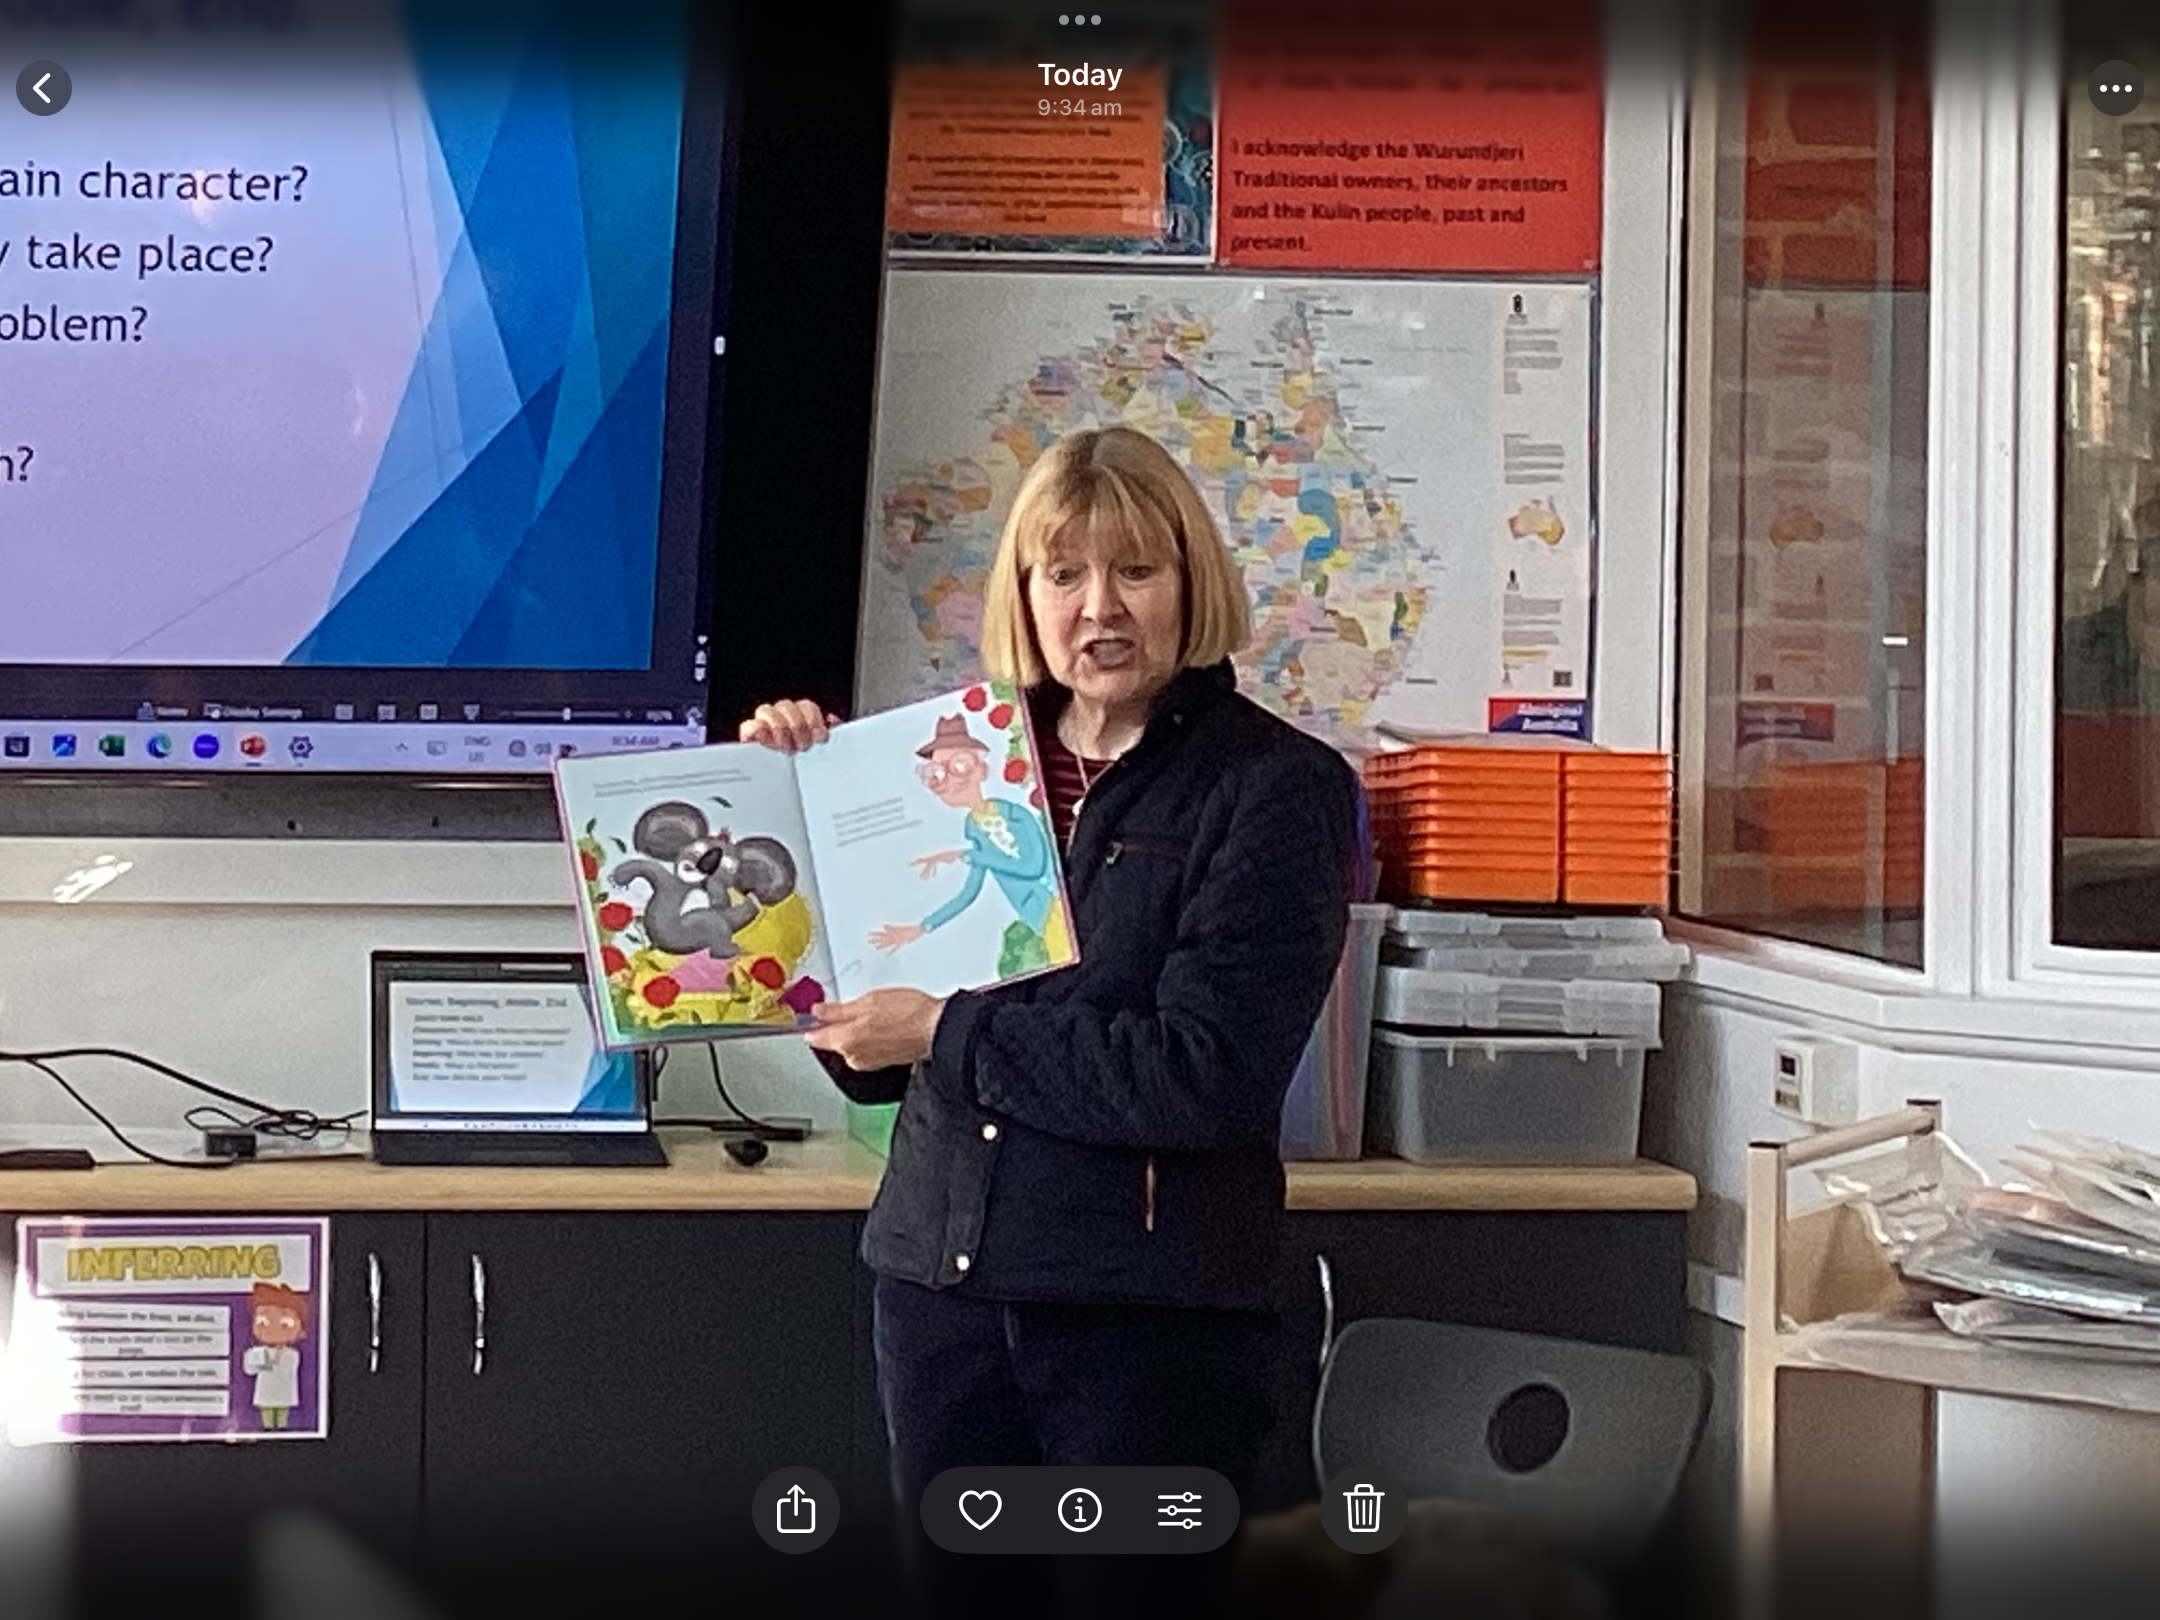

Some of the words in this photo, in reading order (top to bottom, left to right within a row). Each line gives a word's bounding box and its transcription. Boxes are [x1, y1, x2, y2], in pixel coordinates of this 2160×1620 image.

[1243, 139, 1370, 161] acknowledge
[1376, 141, 1409, 158] the
[1413, 142, 1525, 162] Wurundjeri
[79, 160, 308, 202] character?
[1232, 170, 1339, 189] Traditional
[1343, 174, 1421, 192] owners,
[1425, 173, 1473, 190] their
[1476, 175, 1569, 193] ancestors
[1231, 202, 1268, 220] and
[1274, 202, 1306, 220] the
[1311, 203, 1361, 221] Kulin
[1442, 206, 1486, 225] past
[1489, 205, 1526, 224] and
[27, 232, 121, 270] take
[138, 234, 274, 280] place?
[0, 303, 148, 343] oblem?
[464, 735, 491, 747] ENG
[67, 1243, 282, 1282] INFERRING
